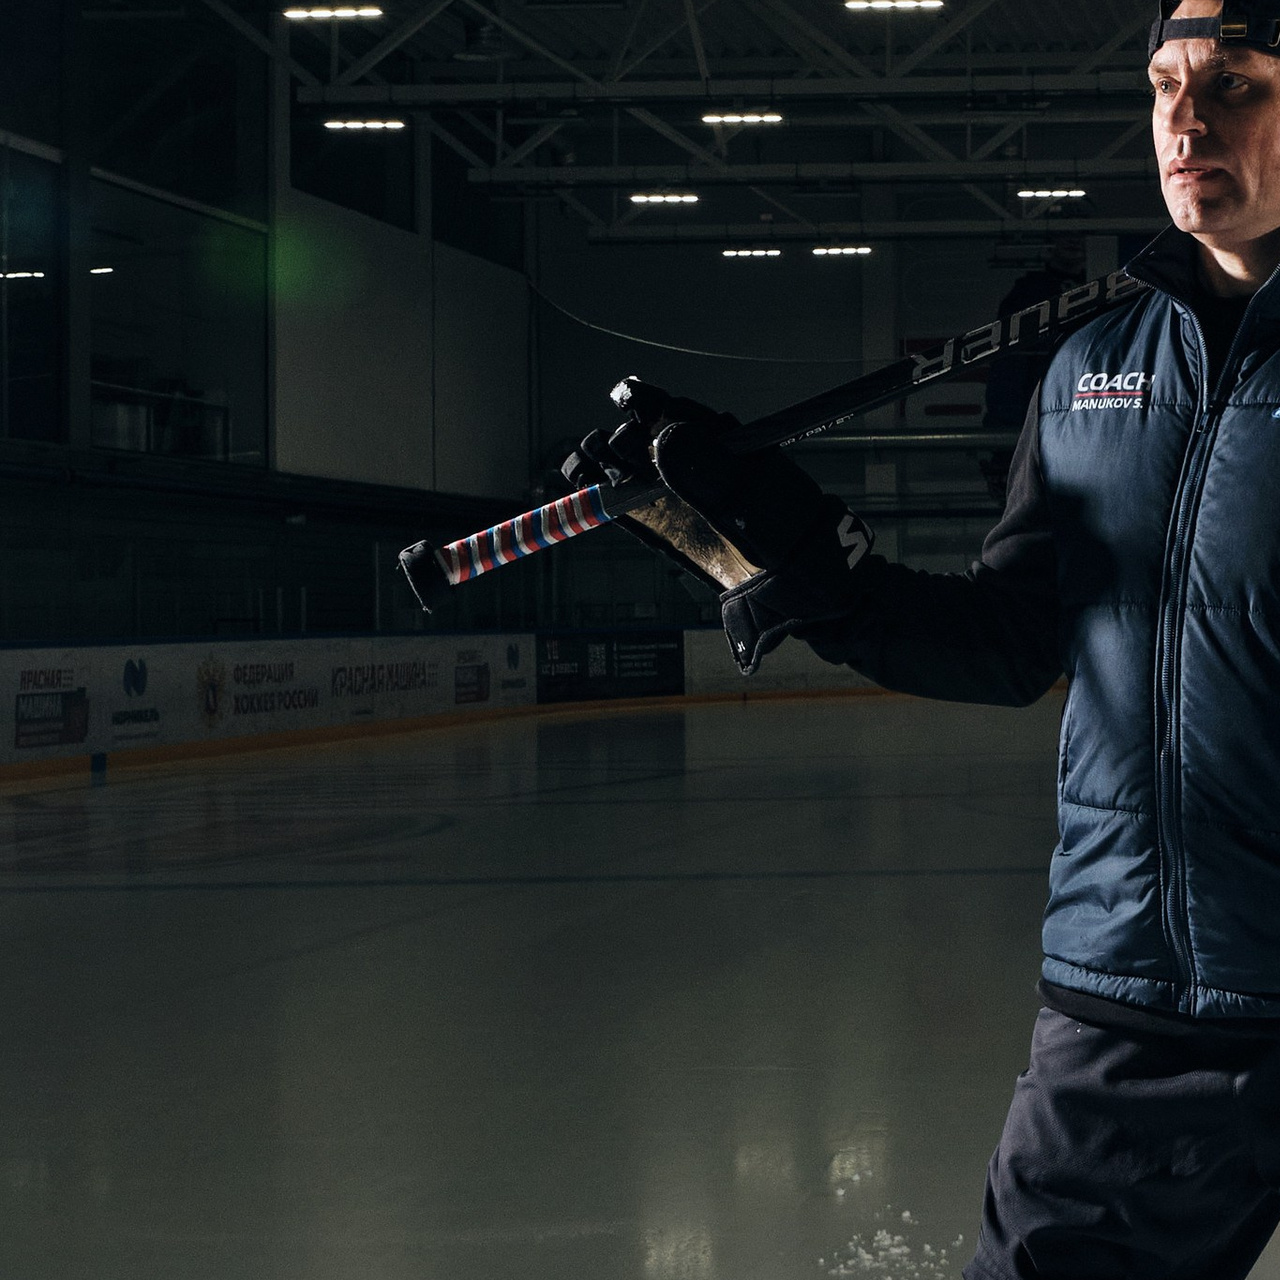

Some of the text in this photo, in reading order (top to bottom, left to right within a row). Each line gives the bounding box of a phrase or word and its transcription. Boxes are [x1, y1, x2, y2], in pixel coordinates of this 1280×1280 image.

[1077, 371, 1156, 393] COACH
[1072, 397, 1144, 412] MANUKOV S.
[233, 662, 294, 684] ФЕДЕРАЦИЯ
[233, 688, 319, 715] ХОККЕЯ РОССИИ
